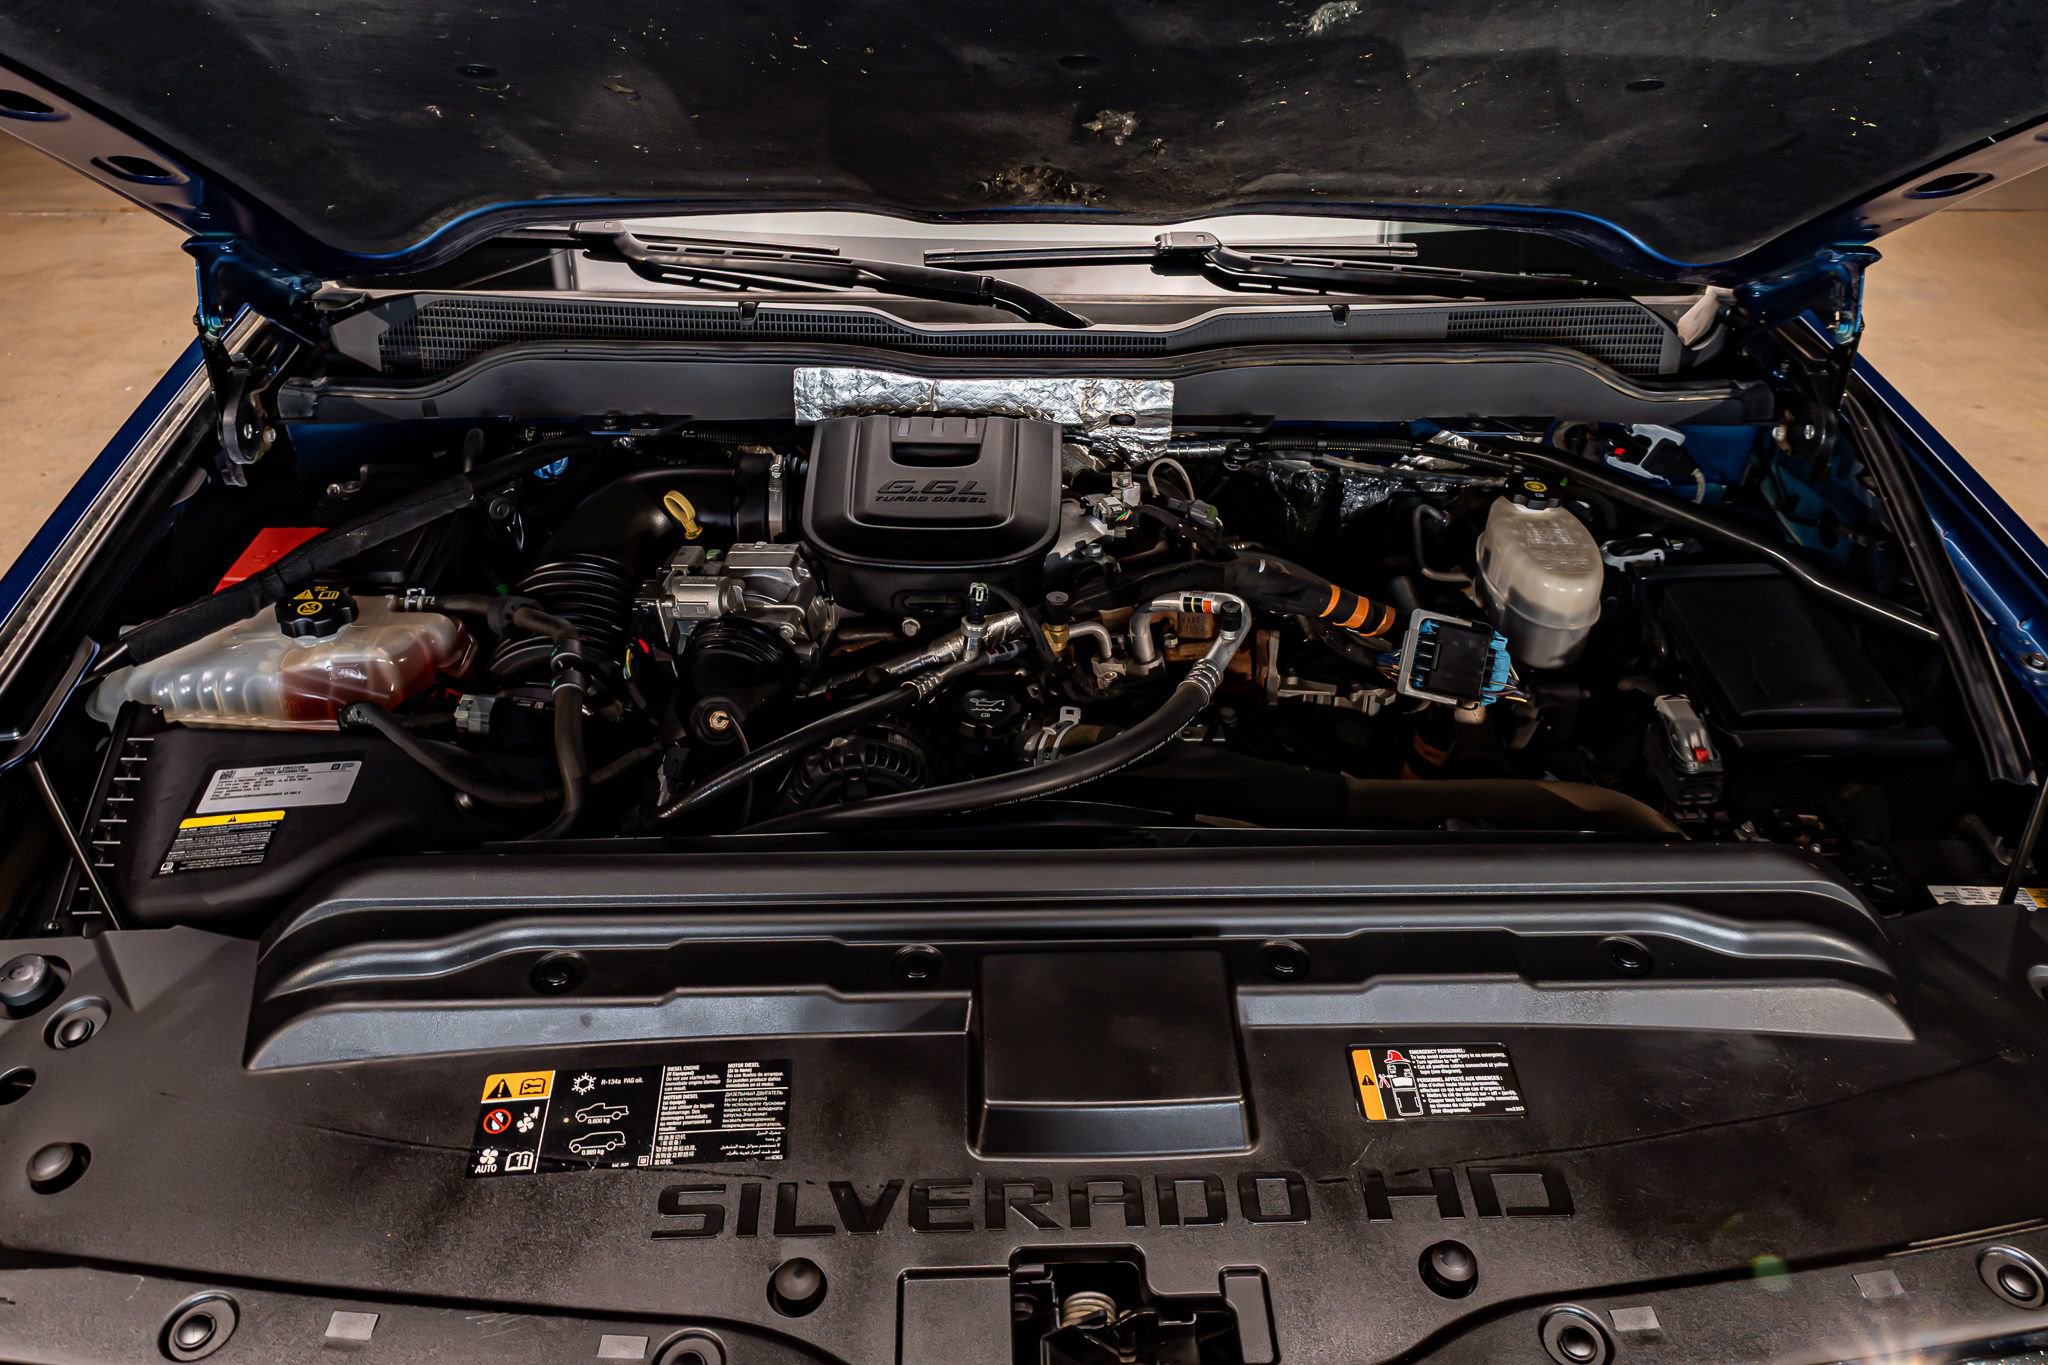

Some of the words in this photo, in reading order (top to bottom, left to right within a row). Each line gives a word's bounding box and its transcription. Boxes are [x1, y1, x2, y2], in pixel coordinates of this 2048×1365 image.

[877, 479, 987, 495] 6.6L
[474, 1164, 497, 1173] AUTO
[651, 1170, 1310, 1240] SILVERADO
[1358, 1166, 1574, 1222] HD
